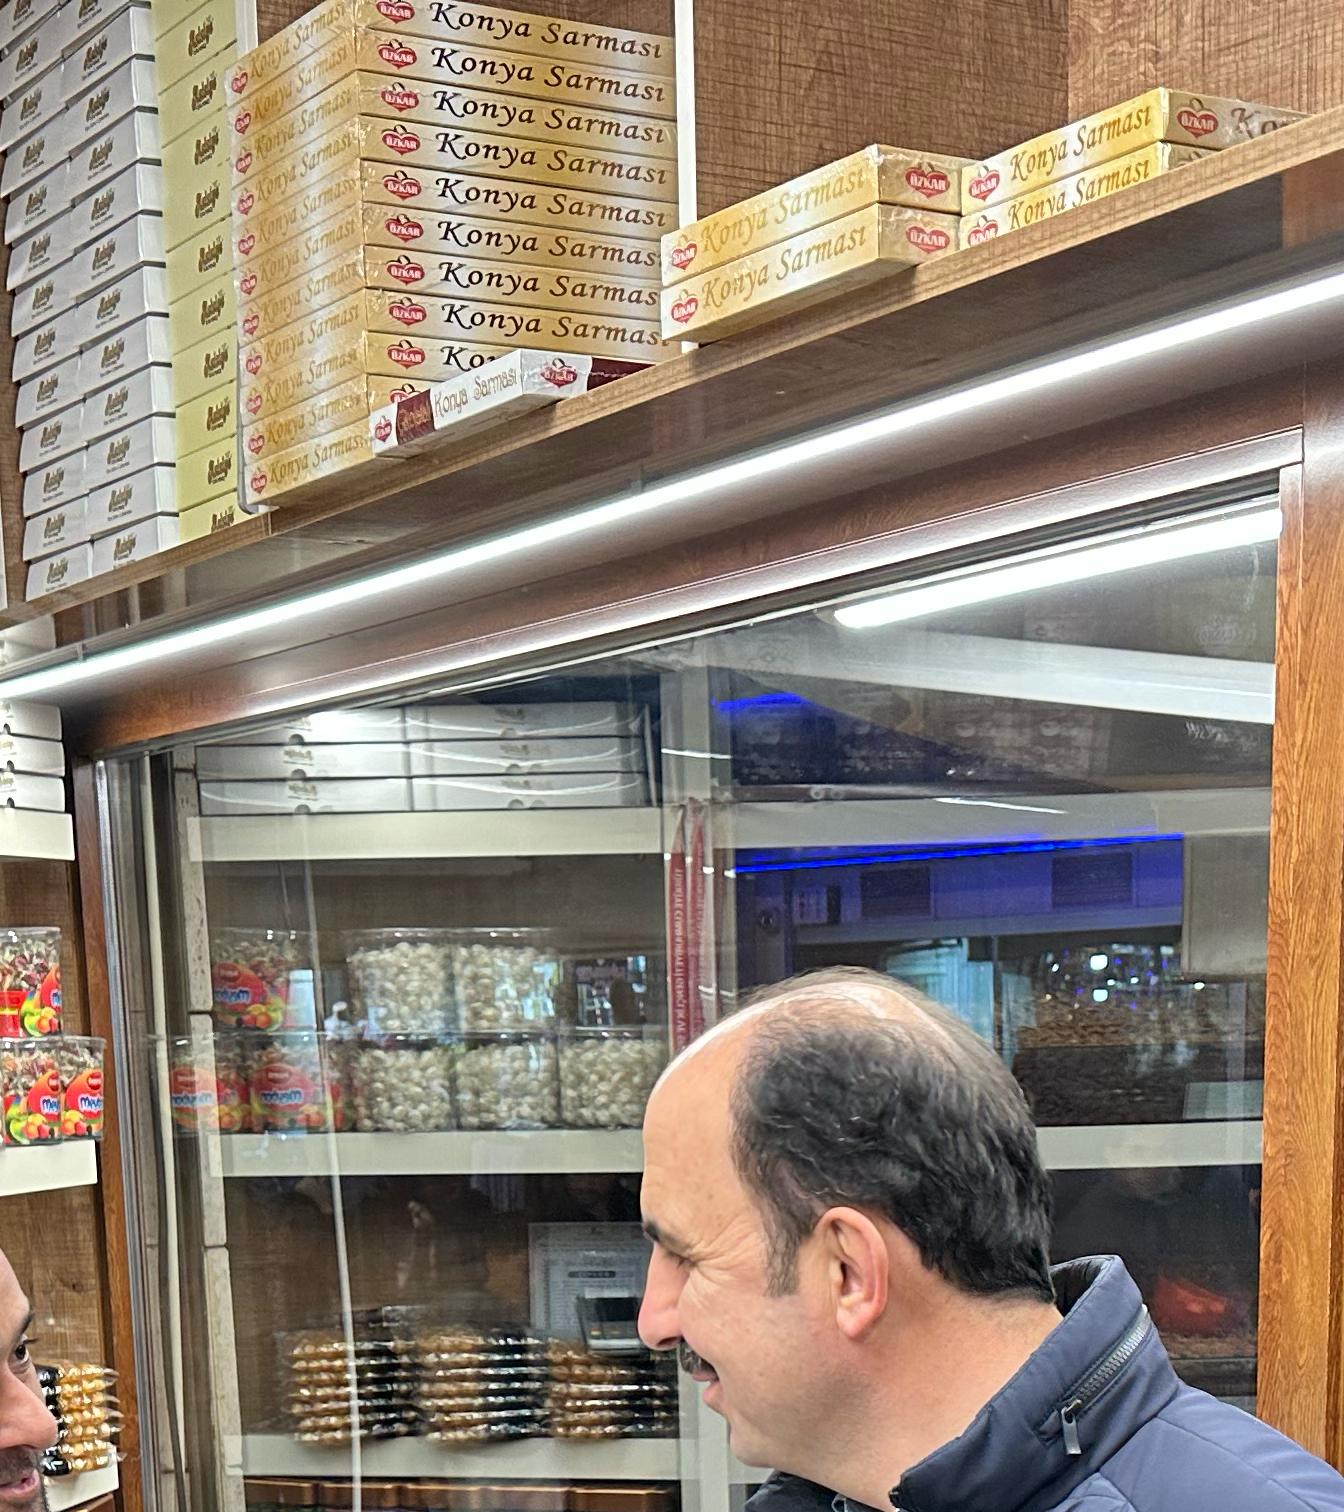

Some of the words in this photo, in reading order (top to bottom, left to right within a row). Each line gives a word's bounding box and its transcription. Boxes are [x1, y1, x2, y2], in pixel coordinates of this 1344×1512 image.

[430, 2, 532, 40] Konya
[542, 23, 663, 59] Sarması
[431, 47, 535, 85] Konya
[545, 65, 666, 102] Sarması
[433, 90, 536, 127] Konya
[545, 109, 666, 144] Sarması
[1010, 140, 1069, 181] Konya
[1073, 103, 1155, 162] Sarması
[436, 132, 537, 169] Konya
[547, 149, 667, 185] Sarması
[436, 177, 537, 212] Konya
[547, 194, 667, 227] Sarması
[700, 205, 767, 255] Konya
[773, 160, 866, 232] Sarması
[1010, 195, 1069, 229] Konya
[1073, 160, 1152, 209] Sarması
[438, 220, 538, 255] Konya
[439, 262, 541, 296] Konya
[550, 275, 657, 307] Sarmas
[701, 261, 770, 309] Konya
[775, 224, 867, 279] Sarması
[441, 303, 543, 337] Konya
[435, 390, 468, 418] Konya
[473, 368, 517, 401] Sarması
